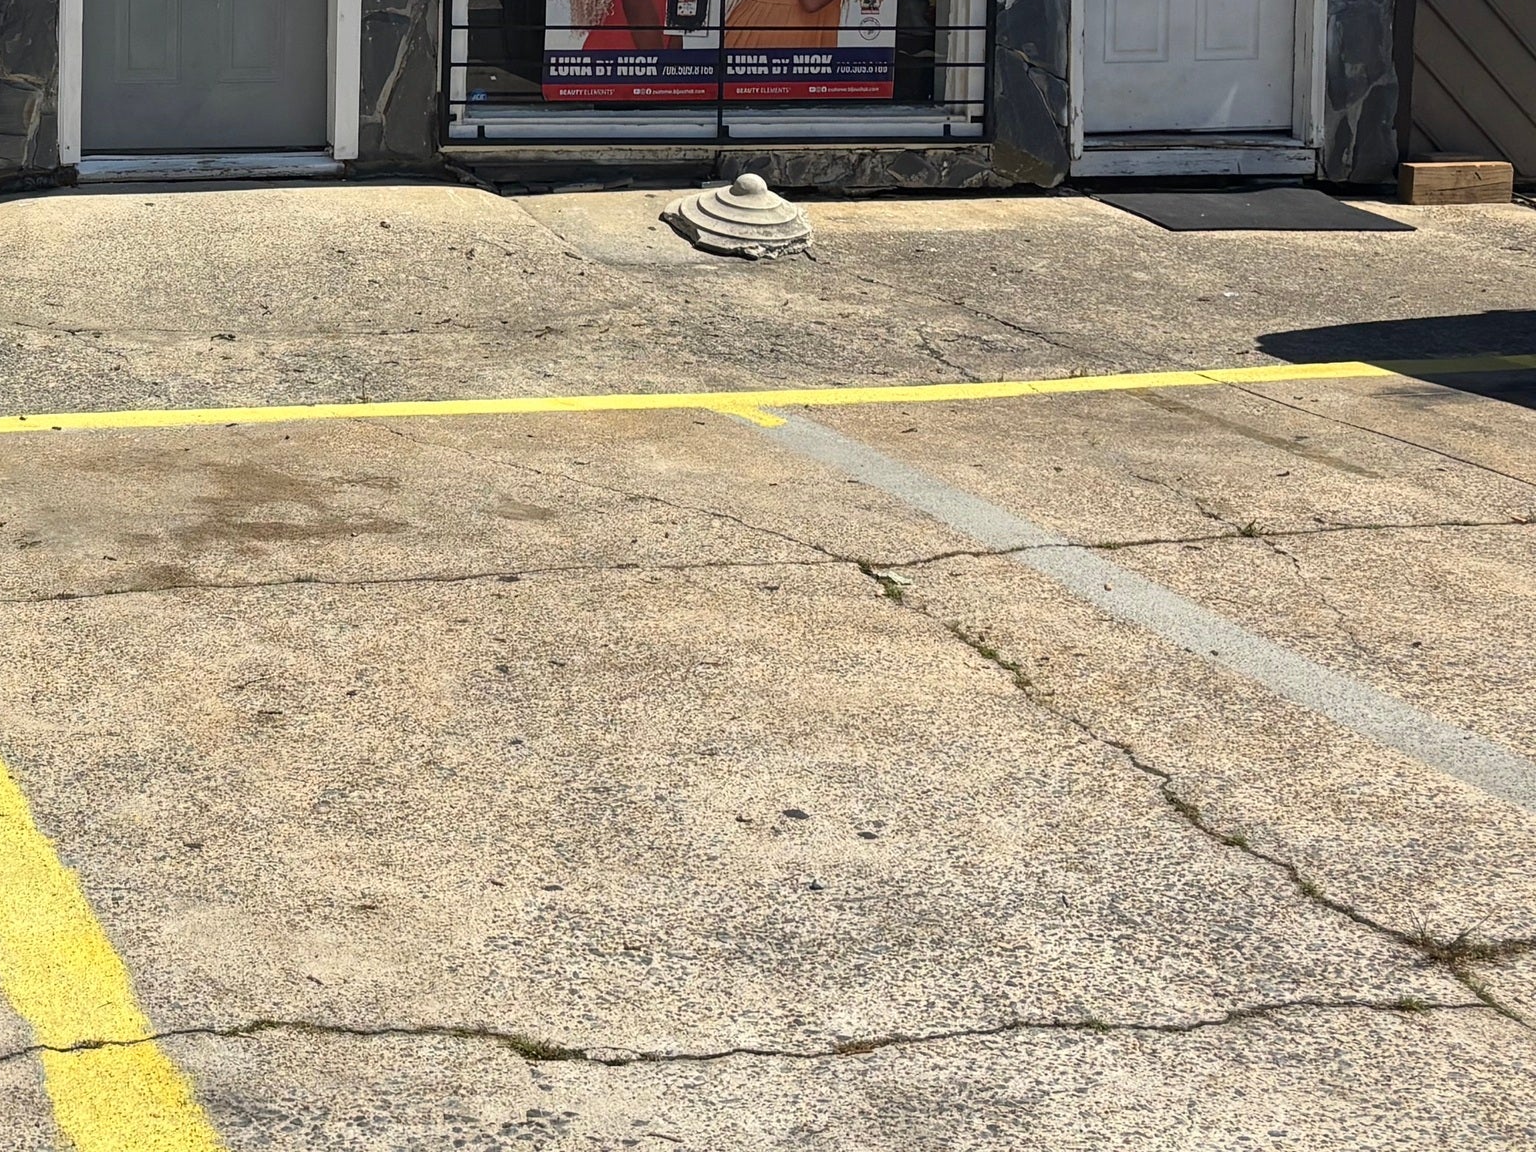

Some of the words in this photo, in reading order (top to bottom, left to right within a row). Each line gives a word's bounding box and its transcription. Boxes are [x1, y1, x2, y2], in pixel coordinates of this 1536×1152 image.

[549, 56, 592, 76] LUNA
[595, 60, 615, 76] BY
[617, 56, 659, 76] NICK
[727, 55, 768, 74] LUNA
[772, 58, 790, 74] BY
[792, 54, 833, 74] NICK
